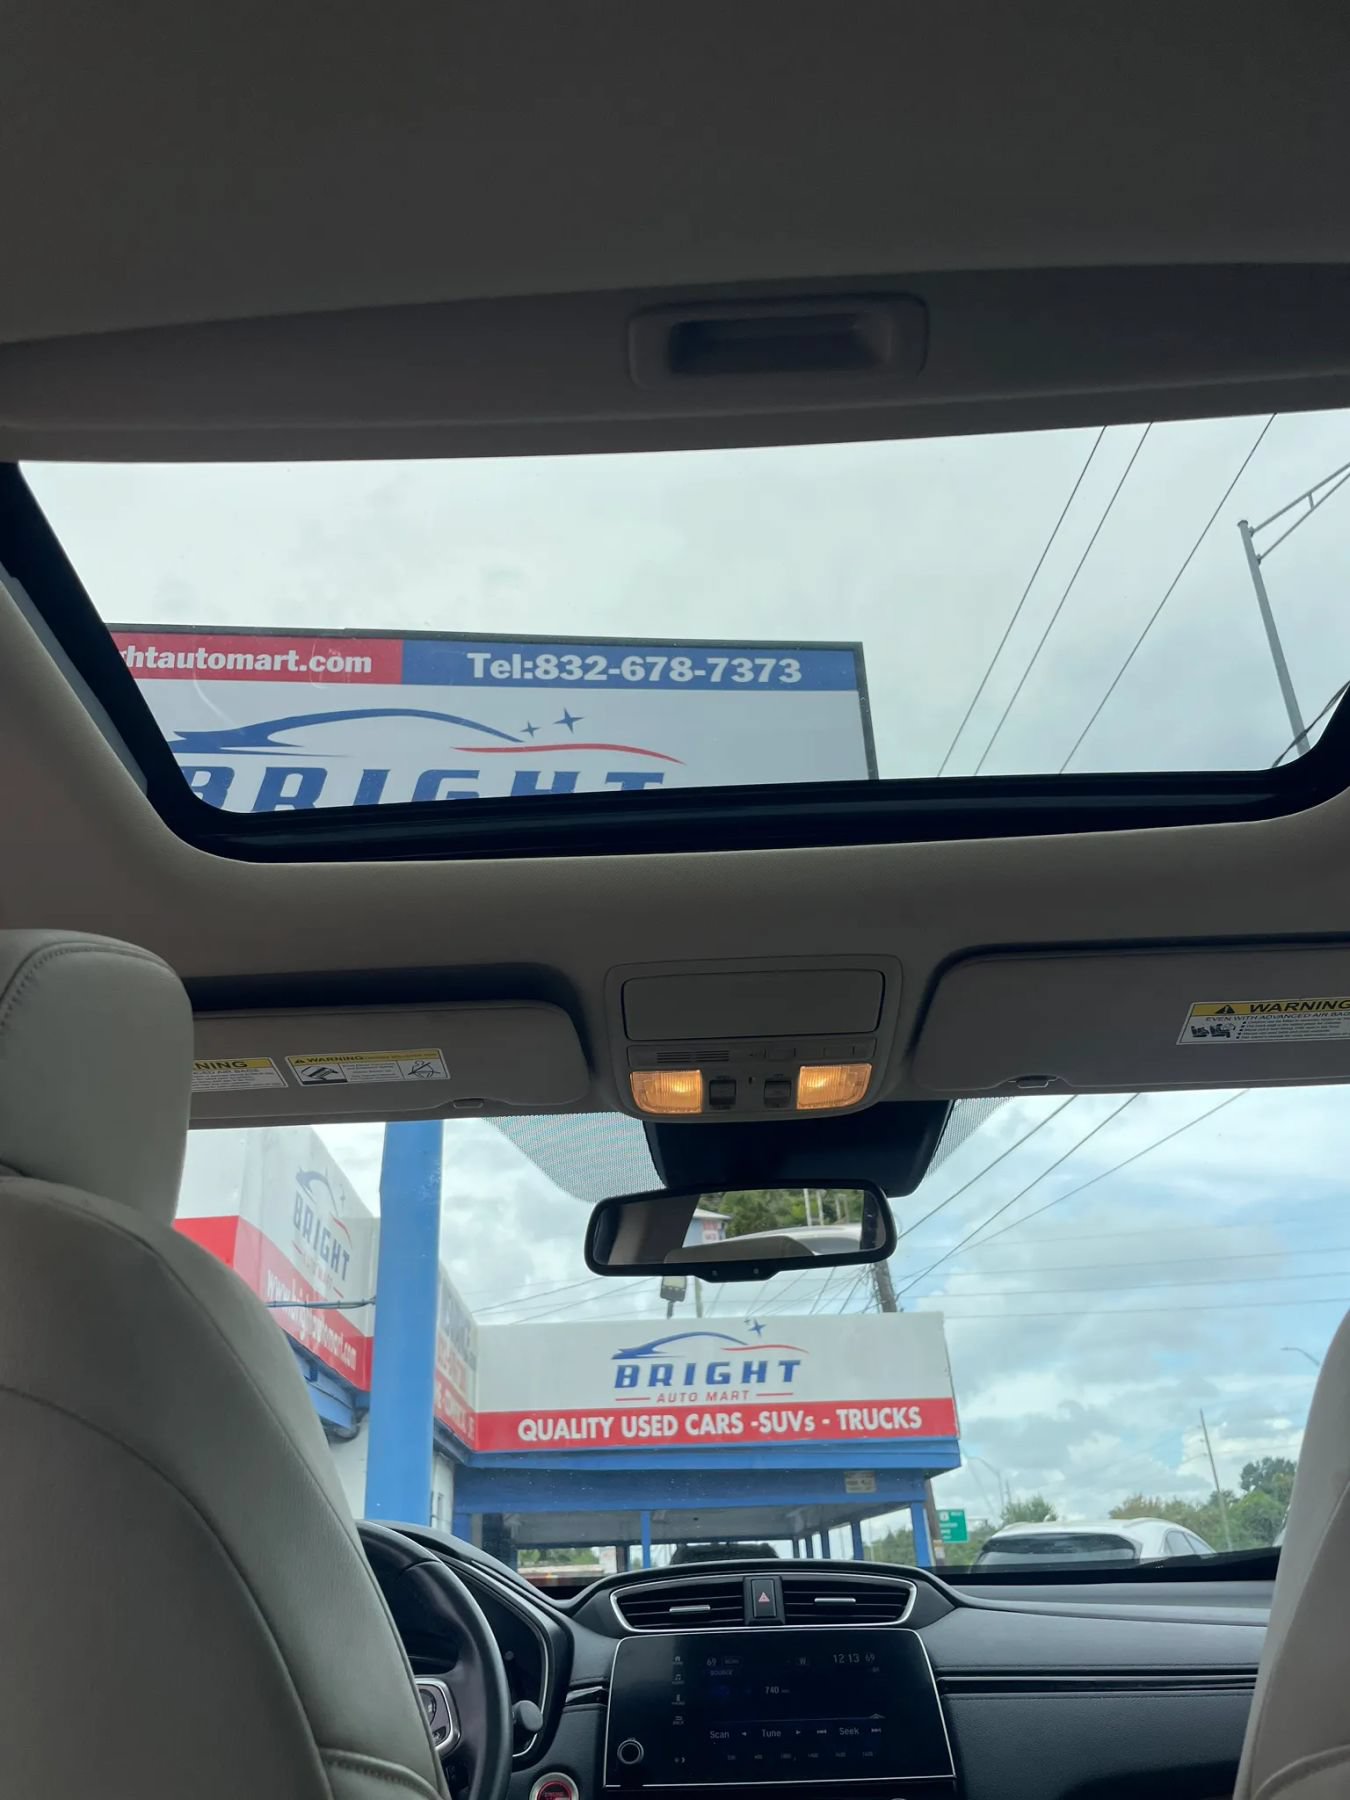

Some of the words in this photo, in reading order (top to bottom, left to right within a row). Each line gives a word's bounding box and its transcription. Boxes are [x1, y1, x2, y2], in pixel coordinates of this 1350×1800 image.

[120, 645, 372, 673] htautomart.com
[467, 652, 802, 684] Tel:832-678-7373
[1250, 1000, 1350, 1012] WARNING
[293, 1189, 351, 1281] BRIGHT
[614, 1360, 801, 1389] BRIGHT
[656, 1392, 698, 1404] AUTO
[705, 1390, 749, 1402] MART
[517, 1417, 614, 1442] QUALITY
[621, 1415, 678, 1438] USED
[685, 1412, 744, 1436] CARS
[836, 1406, 922, 1431] TRUCKS
[709, 1729, 730, 1739] Scan
[761, 1728, 782, 1738] Tune
[838, 1726, 860, 1736] Seek
